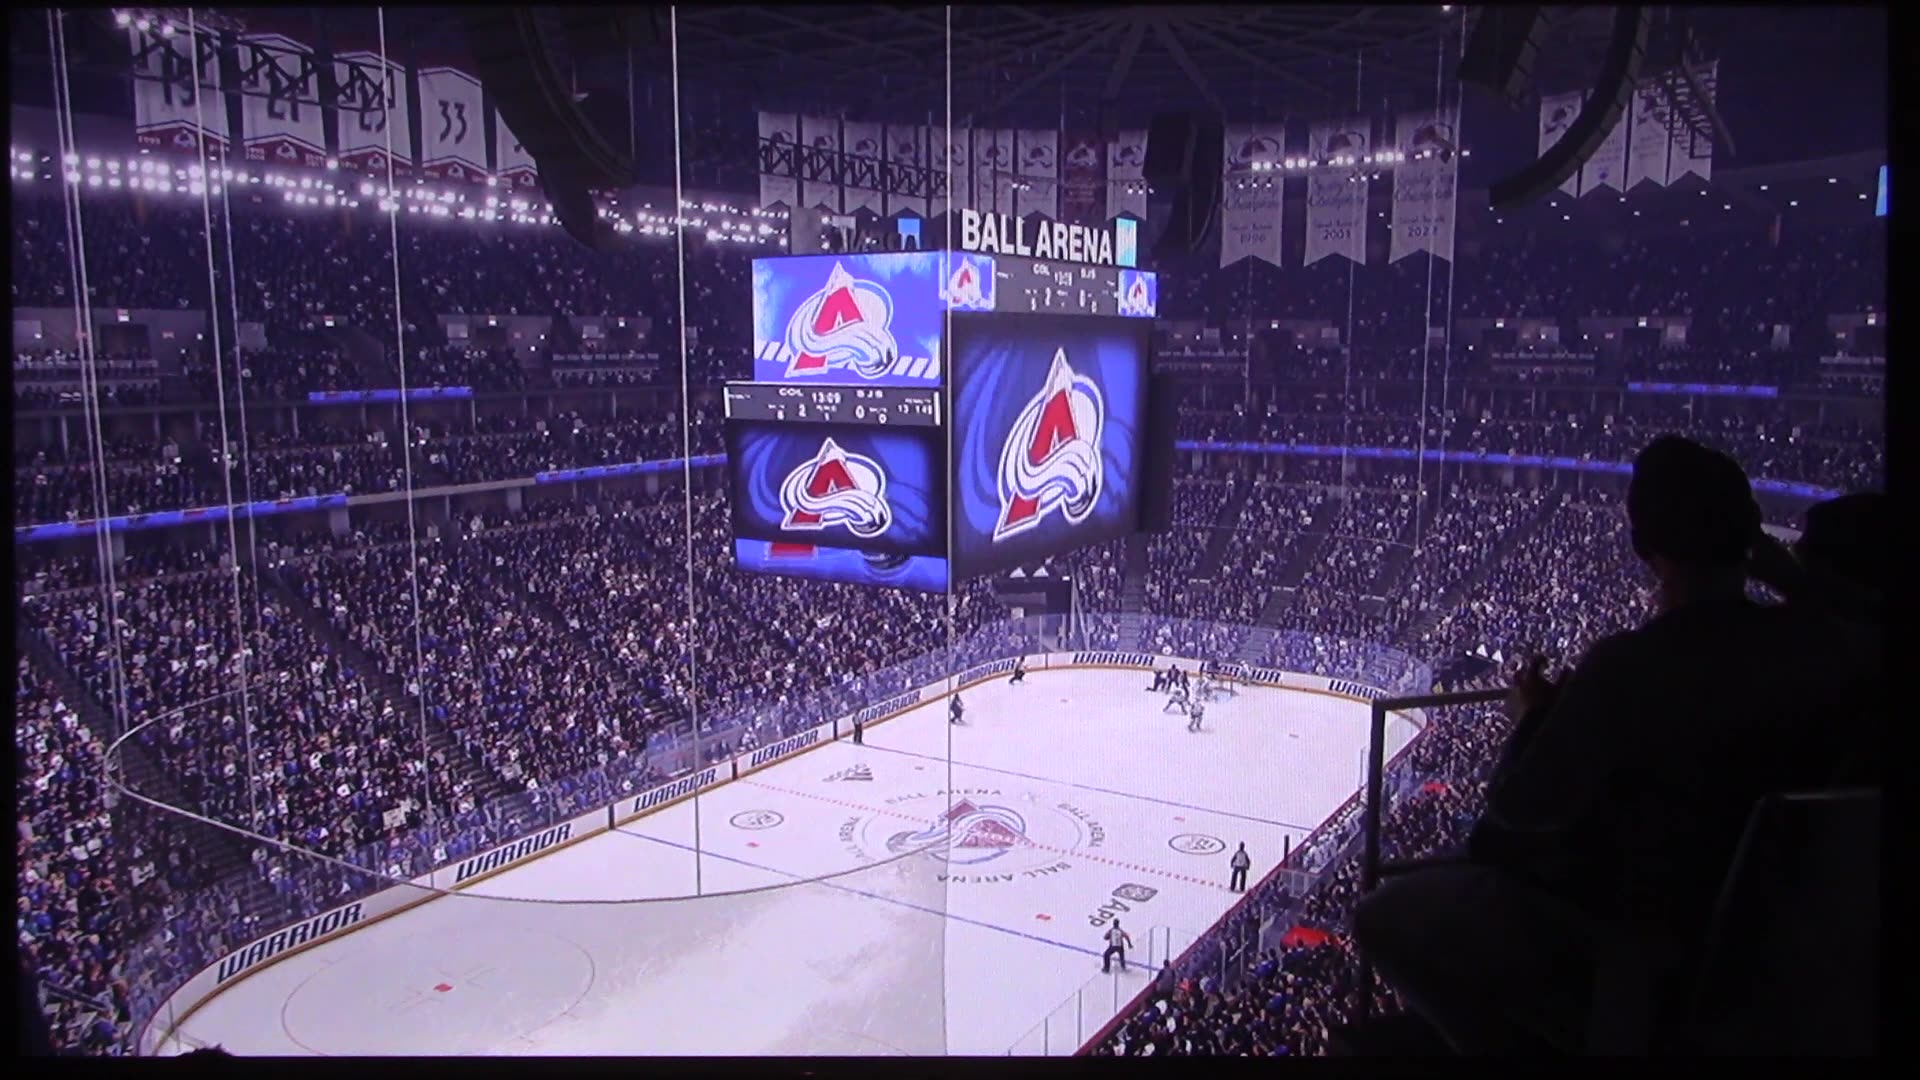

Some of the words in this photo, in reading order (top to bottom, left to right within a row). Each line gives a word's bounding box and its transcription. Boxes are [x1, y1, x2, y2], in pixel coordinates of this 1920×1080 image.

[438, 99, 467, 145] 33
[961, 208, 1031, 257] BALL
[1036, 220, 1113, 266] ARENA
[779, 388, 804, 397] COL
[855, 405, 865, 419] 0
[958, 659, 1016, 686] WARRIOR
[1073, 653, 1155, 665] WARRIOR
[860, 690, 921, 721] WARRIOR
[751, 730, 819, 767] WARRIOR
[634, 768, 717, 812] WARRIOR
[455, 823, 573, 883] WARRIOR
[217, 902, 363, 984] WARRIOR
